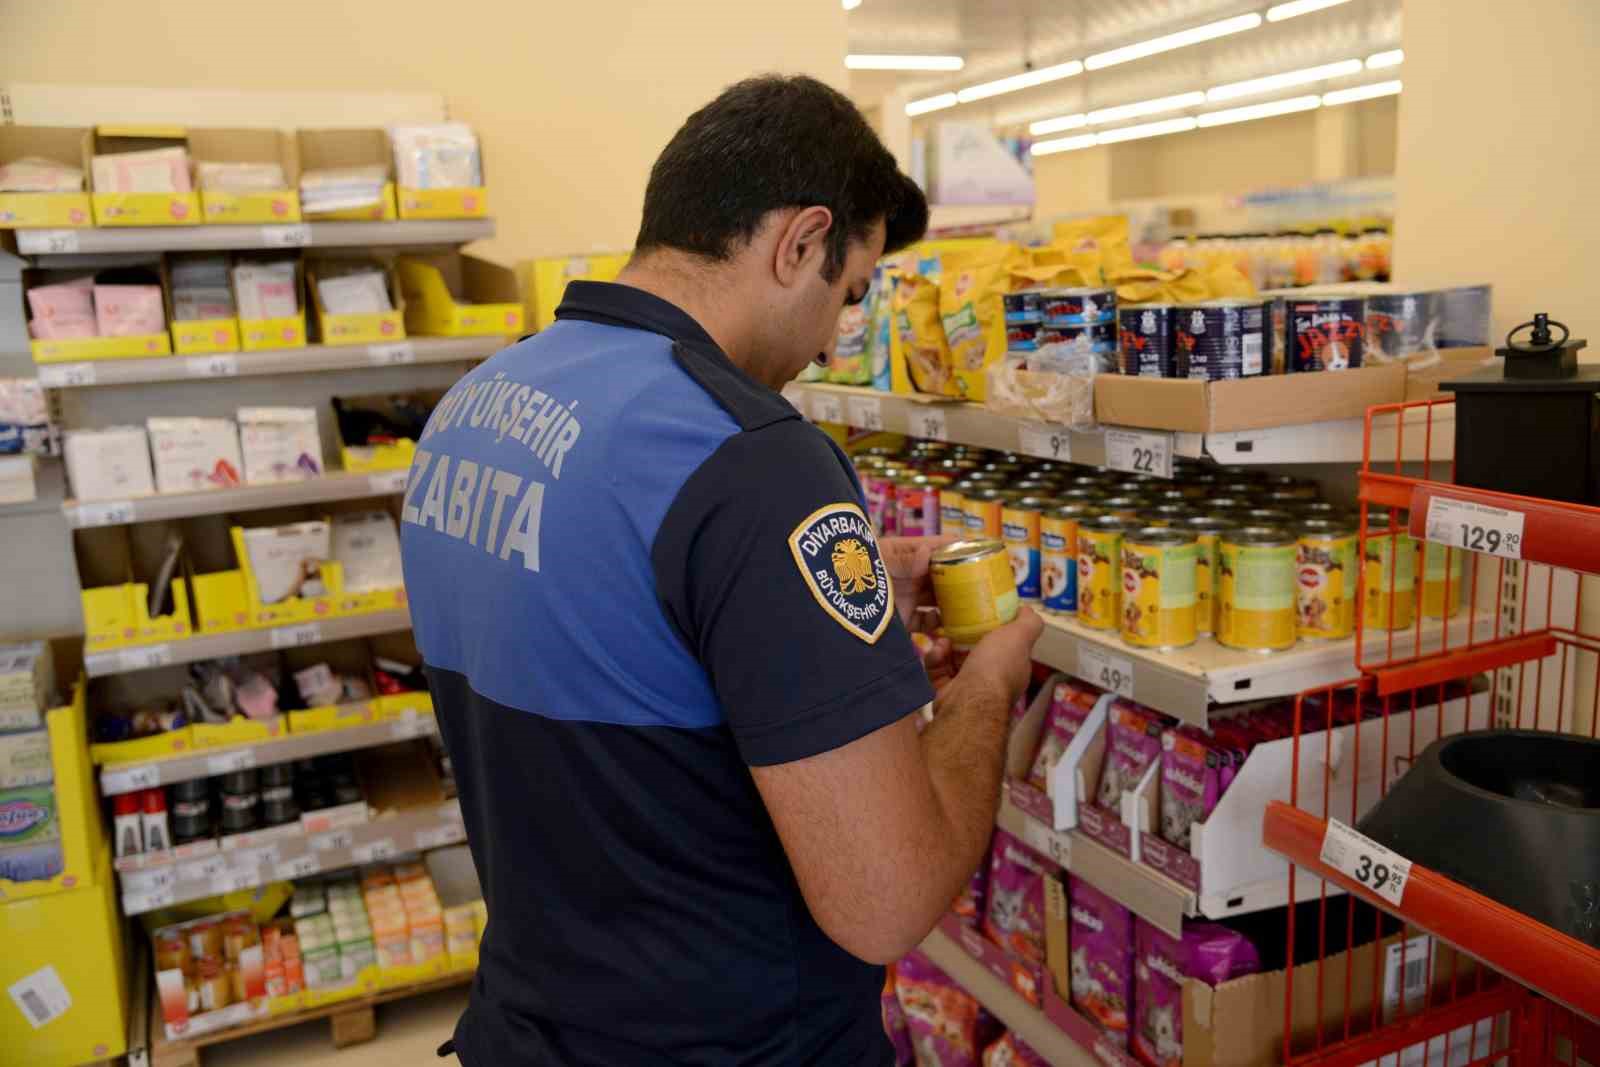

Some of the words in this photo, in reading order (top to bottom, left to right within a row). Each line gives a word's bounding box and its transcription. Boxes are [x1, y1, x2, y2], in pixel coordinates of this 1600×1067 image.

[1132, 448, 1154, 472] 22
[401, 450, 546, 573] ZABITA
[801, 516, 874, 556] DİYARBAKIR
[1460, 523, 1502, 553] 129
[815, 569, 881, 620] BÜYÜKŞEHİR
[874, 559, 888, 606] ZABITA
[1100, 666, 1122, 689] 49
[1355, 855, 1389, 889] 39
